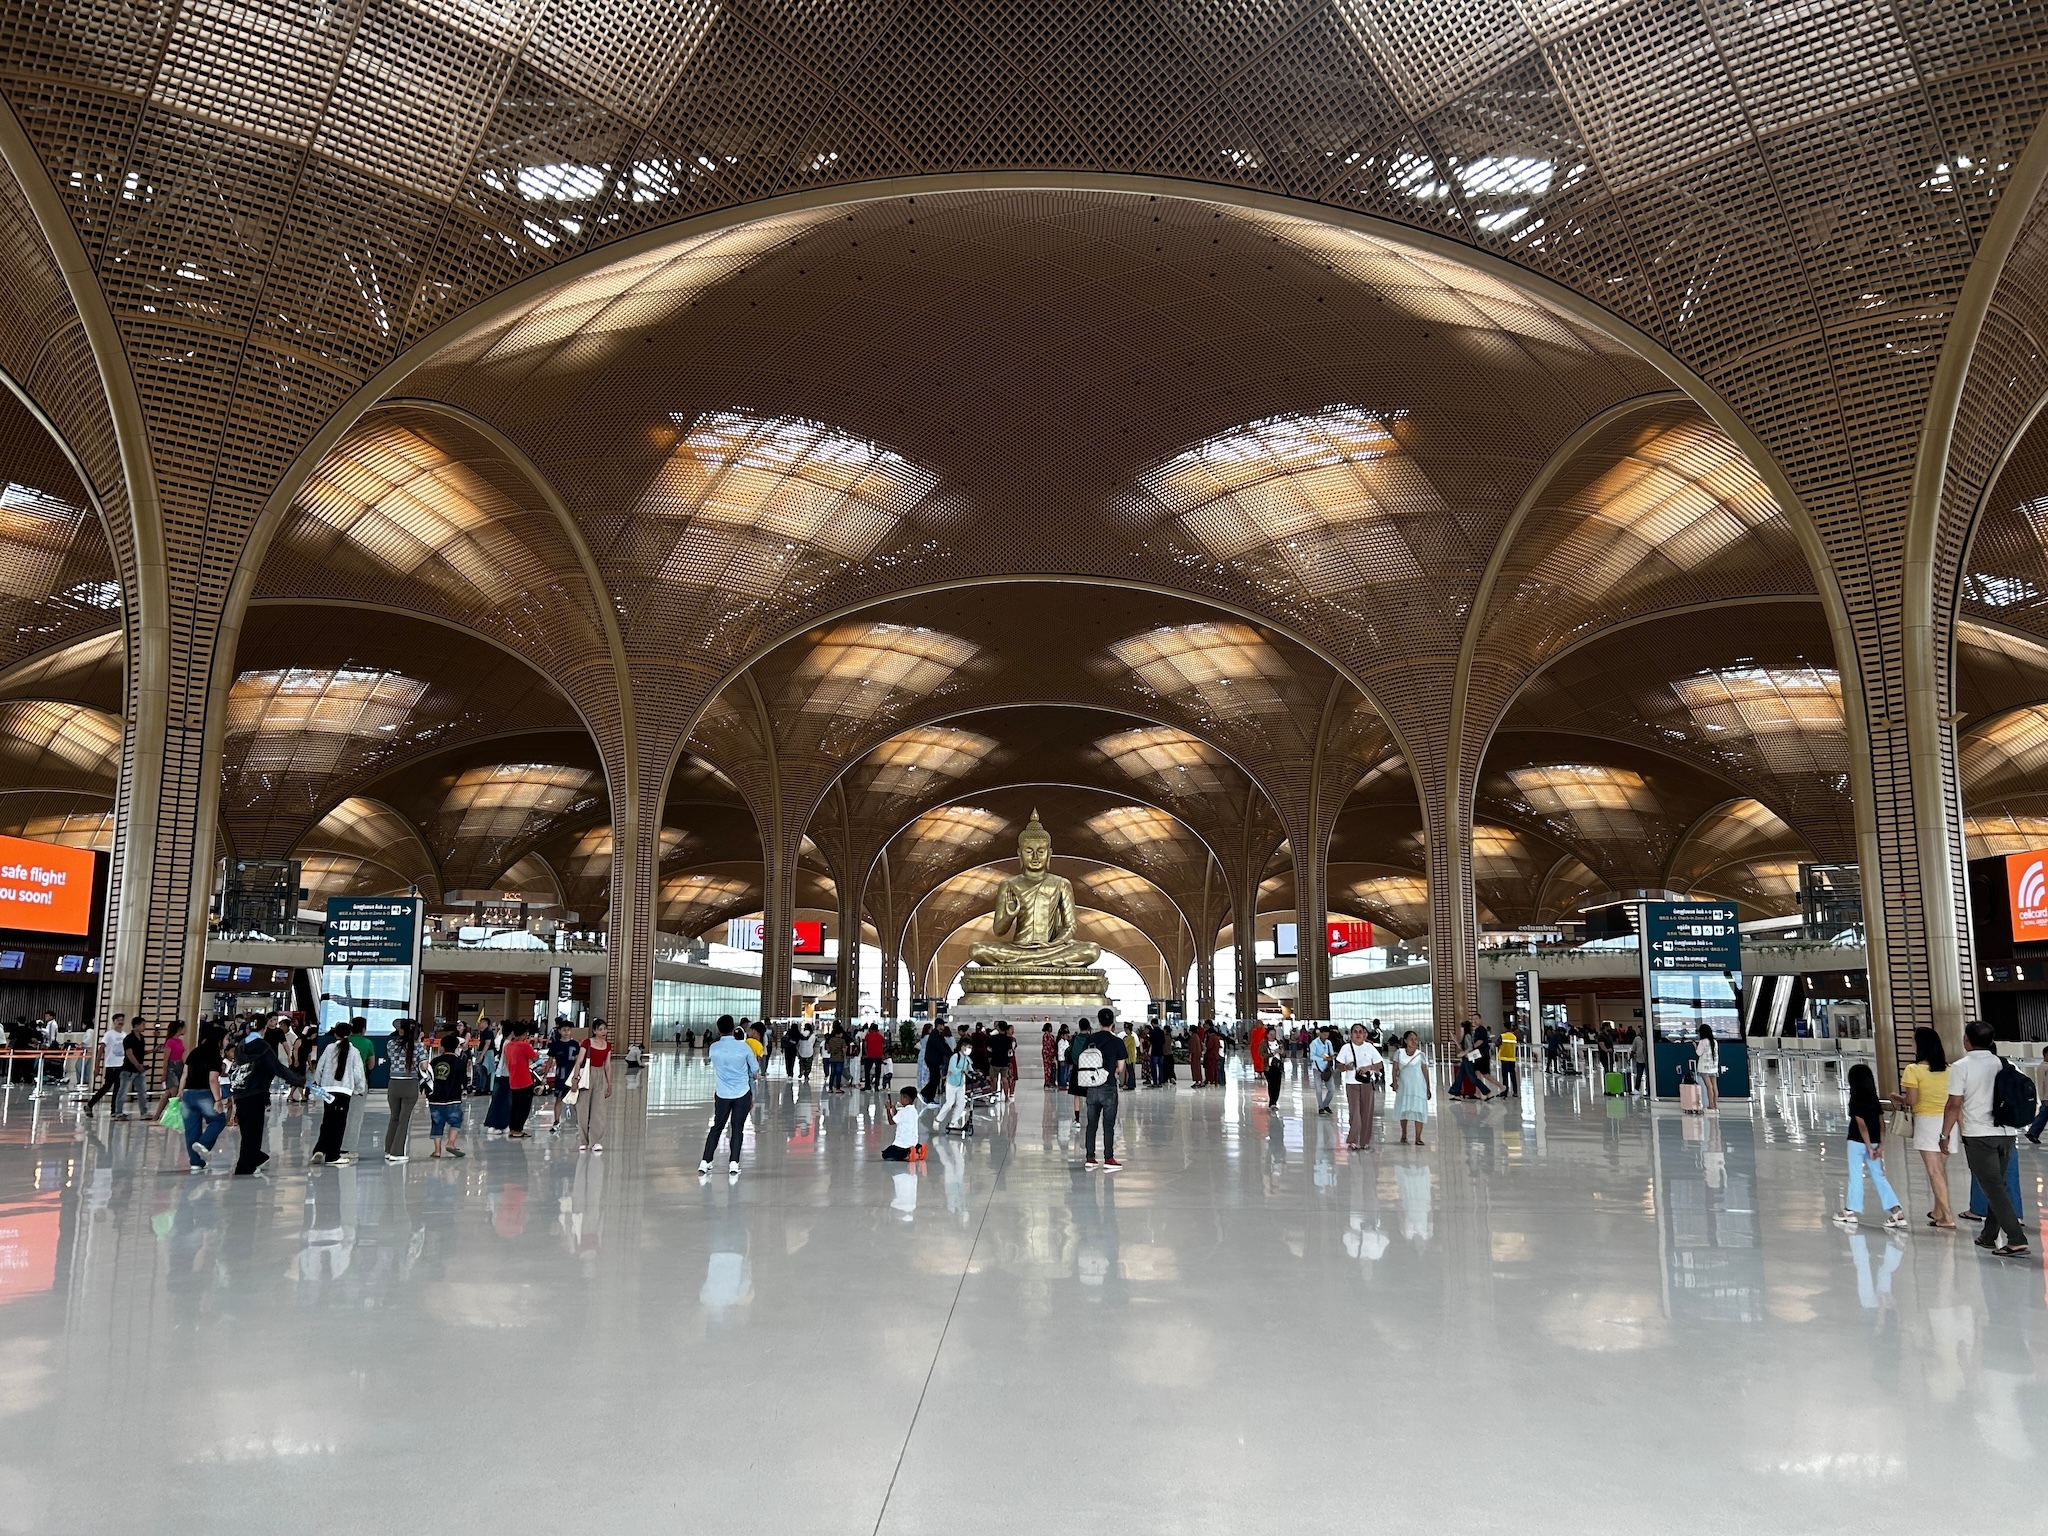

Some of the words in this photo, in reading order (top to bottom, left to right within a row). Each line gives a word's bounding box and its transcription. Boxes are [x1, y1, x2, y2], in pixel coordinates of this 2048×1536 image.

[1, 864, 28, 880] safe
[30, 867, 66, 886] flight!
[0, 887, 16, 900] ou
[18, 889, 53, 904] soon!
[1517, 924, 1558, 932] columbus
